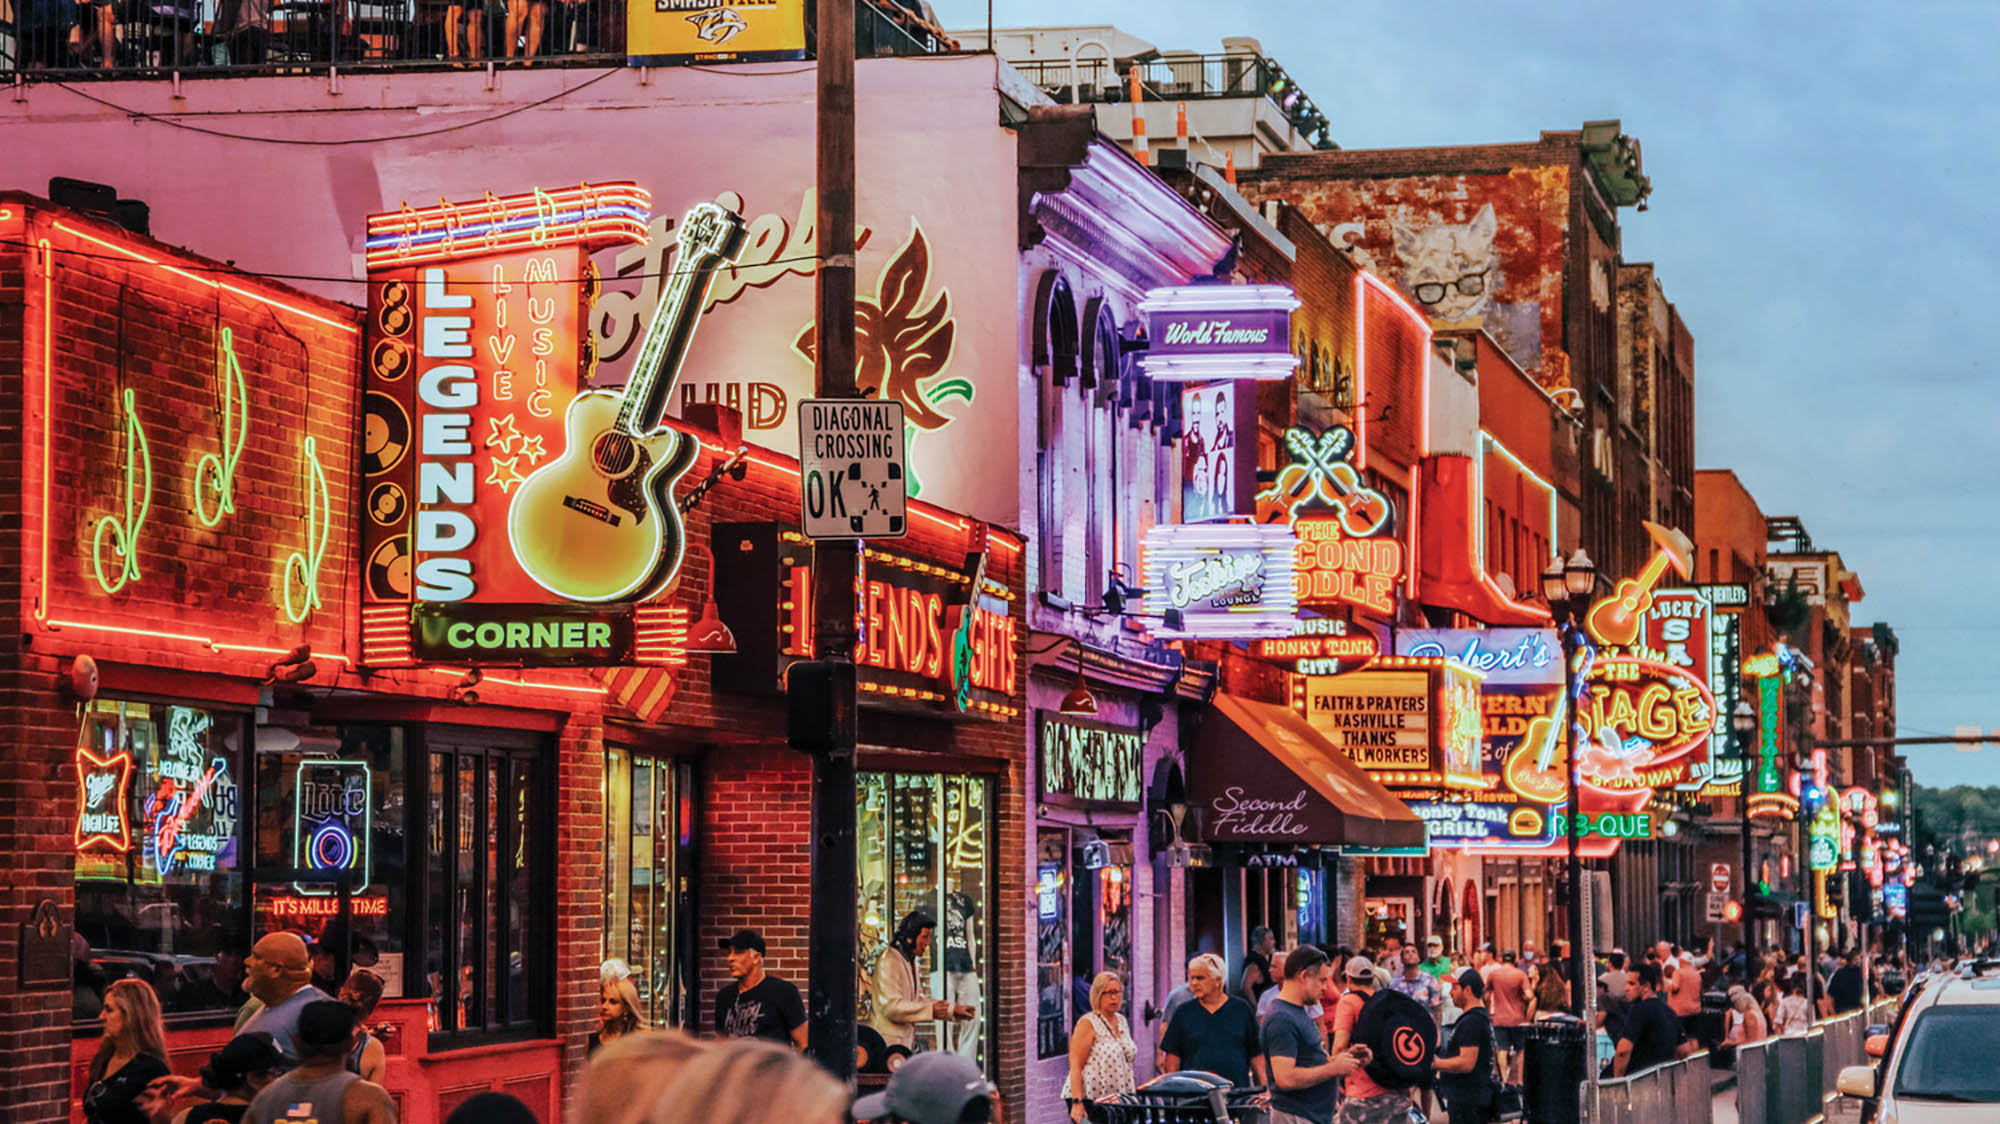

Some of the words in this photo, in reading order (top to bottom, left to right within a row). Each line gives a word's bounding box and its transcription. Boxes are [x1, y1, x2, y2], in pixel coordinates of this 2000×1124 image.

[489, 264, 515, 401] LIVE
[524, 258, 558, 418] MUSIC
[1164, 321, 1214, 344] World
[1213, 320, 1269, 344] Famous
[812, 406, 893, 431] DIAGONAL
[416, 268, 478, 602] LEGENDS
[815, 434, 893, 459] CROSSING
[807, 470, 847, 519] OK
[1296, 521, 1340, 540] THE
[1297, 540, 1401, 577] COND
[1212, 593, 1261, 608] LOUNGE
[1296, 571, 1393, 615] DDLE
[1650, 600, 1705, 620] LUCKY
[447, 622, 611, 649] CORNER
[1292, 619, 1347, 636] MUSIC
[970, 606, 1017, 696] GIFTS
[1264, 639, 1321, 656] HONKY
[1326, 639, 1375, 656] TONK
[1297, 658, 1339, 675] CITY
[1603, 663, 1640, 680] THE
[1712, 614, 1732, 756] WHISKEY
[1314, 696, 1354, 710] FAITH
[1356, 696, 1365, 710] &
[1367, 696, 1426, 711] PRAYERS
[1578, 683, 1710, 739] TAGE
[1334, 713, 1405, 729] NASHVILLE
[1342, 731, 1397, 746] THANKS
[1364, 748, 1428, 763] WORKERS
[1495, 741, 1514, 766] of
[301, 781, 366, 824] Lite
[1213, 786, 1308, 812] Second
[101, 813, 121, 833] LIFE
[1212, 810, 1309, 836] Fiddle
[1463, 803, 1509, 824] Tonk
[1430, 820, 1489, 836] GRILL
[1248, 854, 1299, 867] ATM
[273, 898, 297, 915] IT'S
[299, 898, 339, 915] MILLE
[351, 899, 387, 915] TIME
